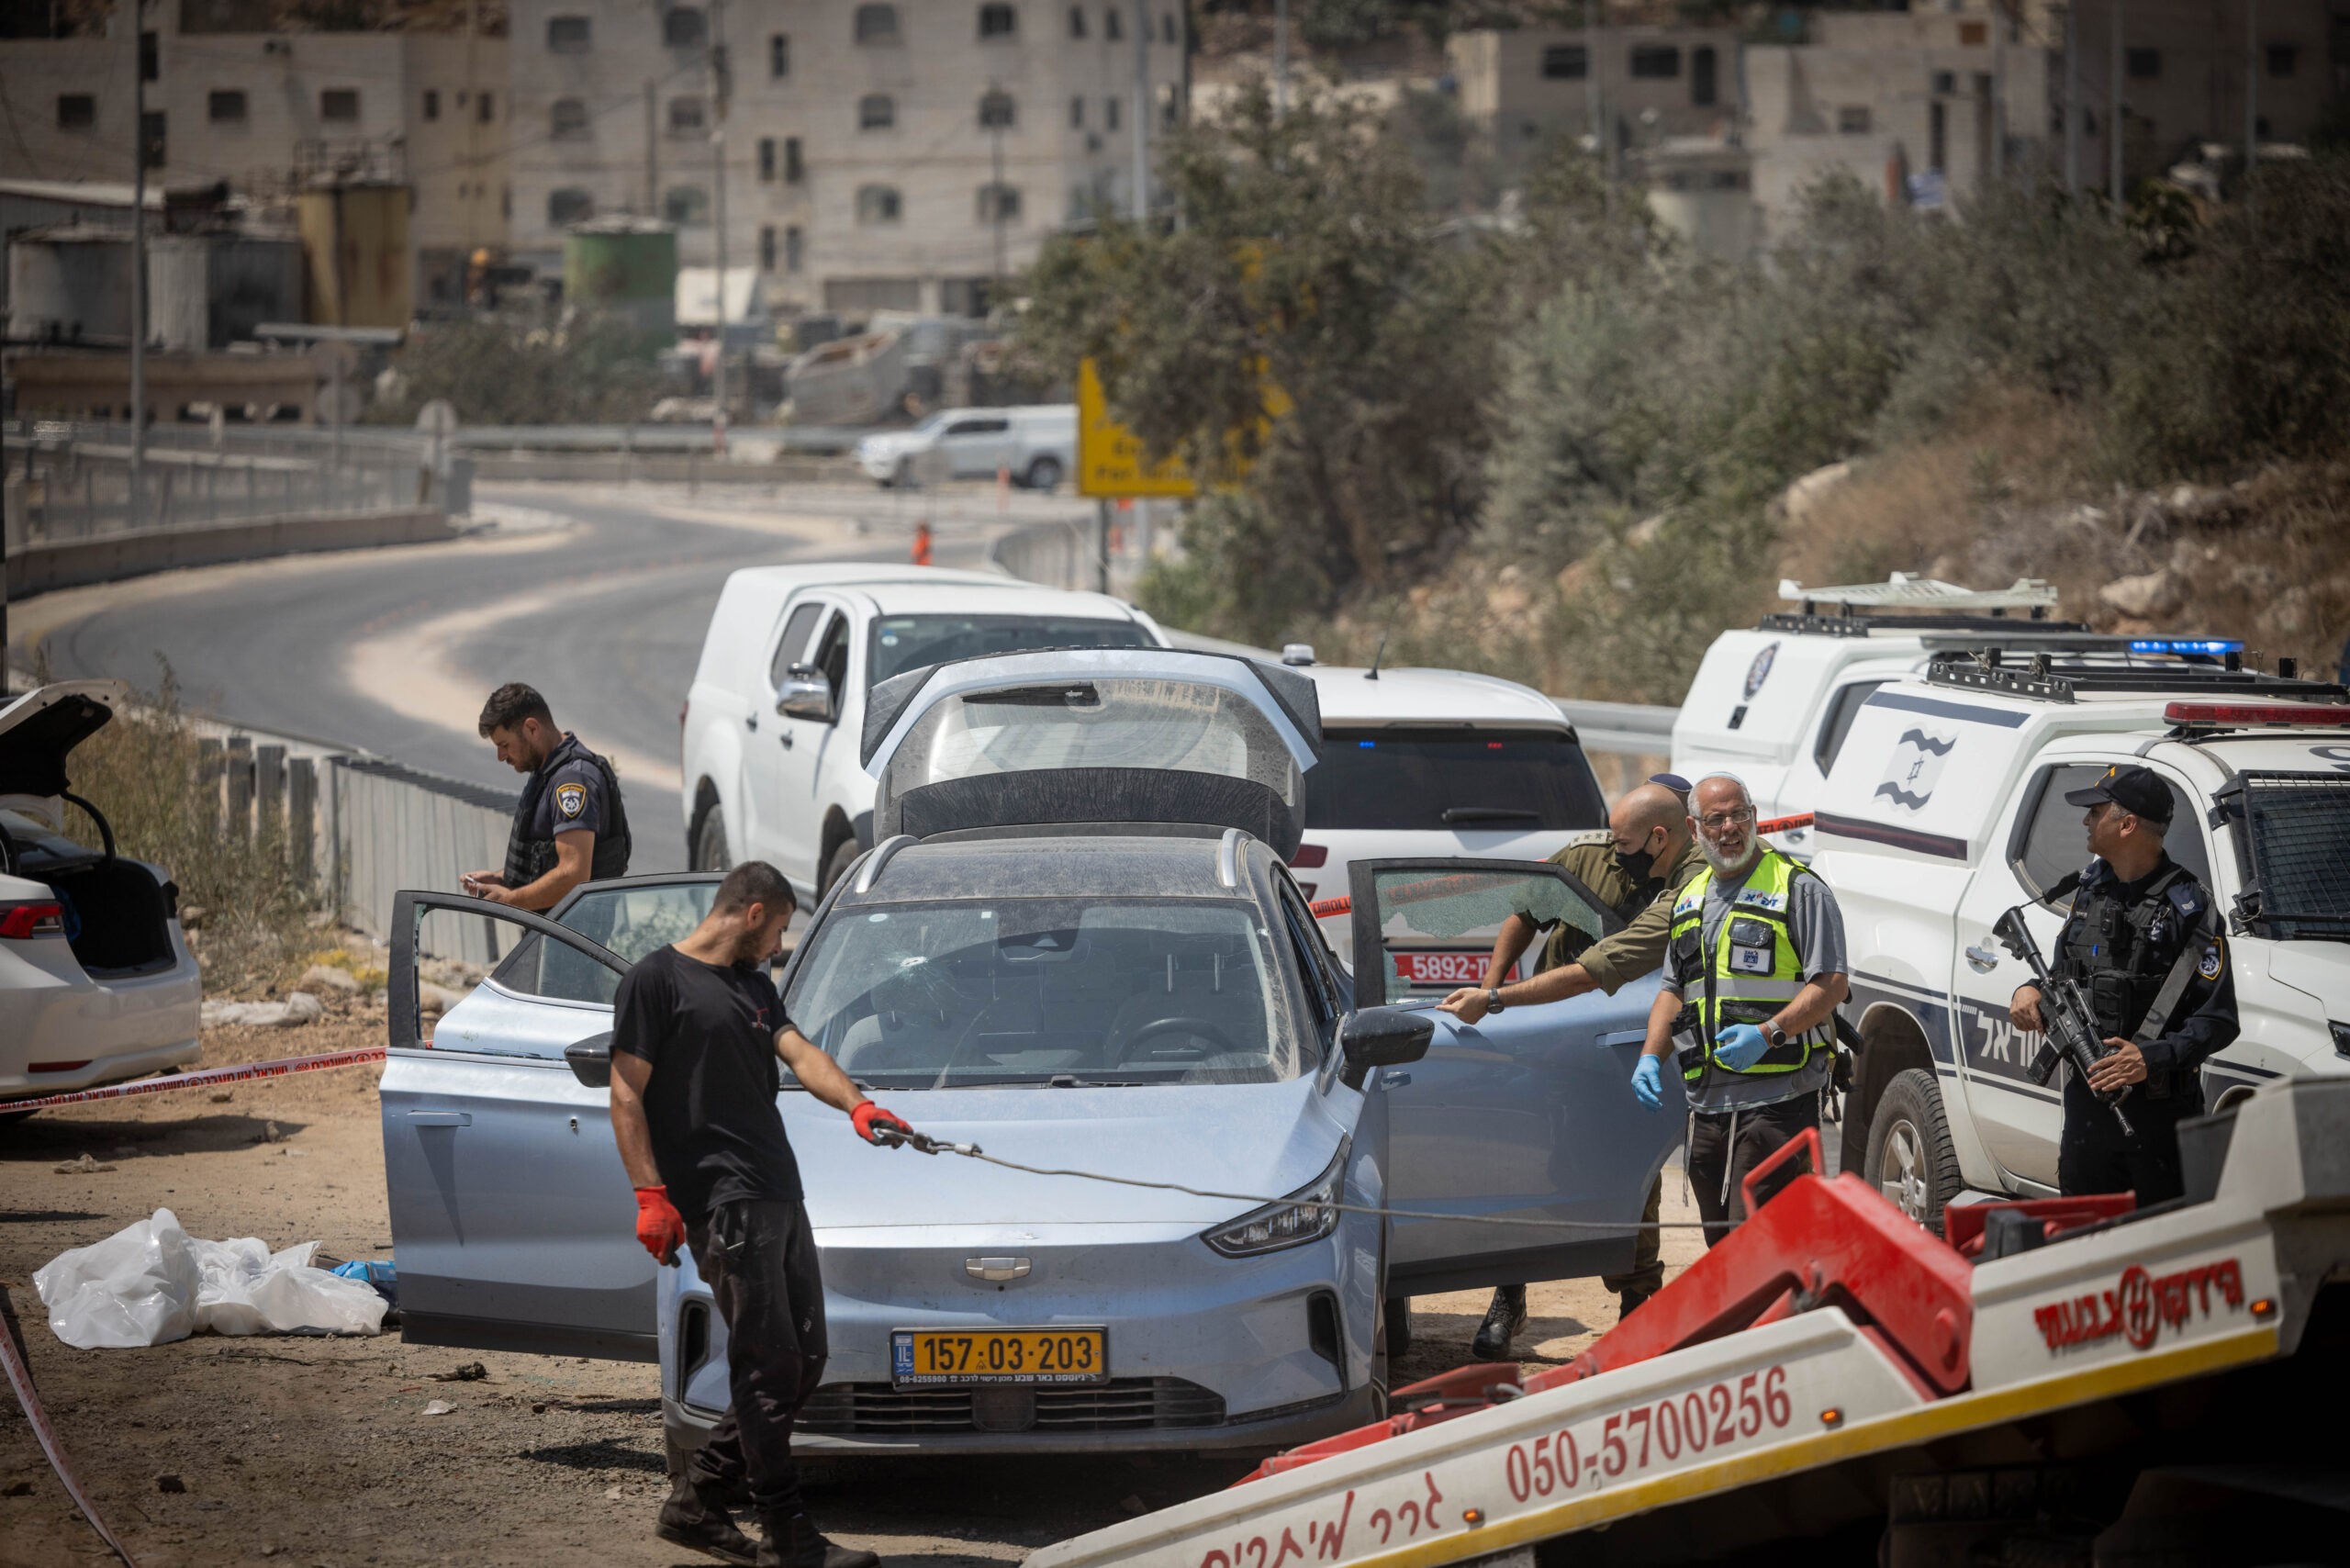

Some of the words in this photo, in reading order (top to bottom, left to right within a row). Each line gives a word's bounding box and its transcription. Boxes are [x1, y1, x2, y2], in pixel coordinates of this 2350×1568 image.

[1976, 1010, 2047, 1068] שראל
[252, 1065, 287, 1079] ישראל
[898, 1346, 911, 1362] IL
[1506, 1364, 1793, 1503] 050-5700256
[1370, 1471, 1443, 1545] גרר
